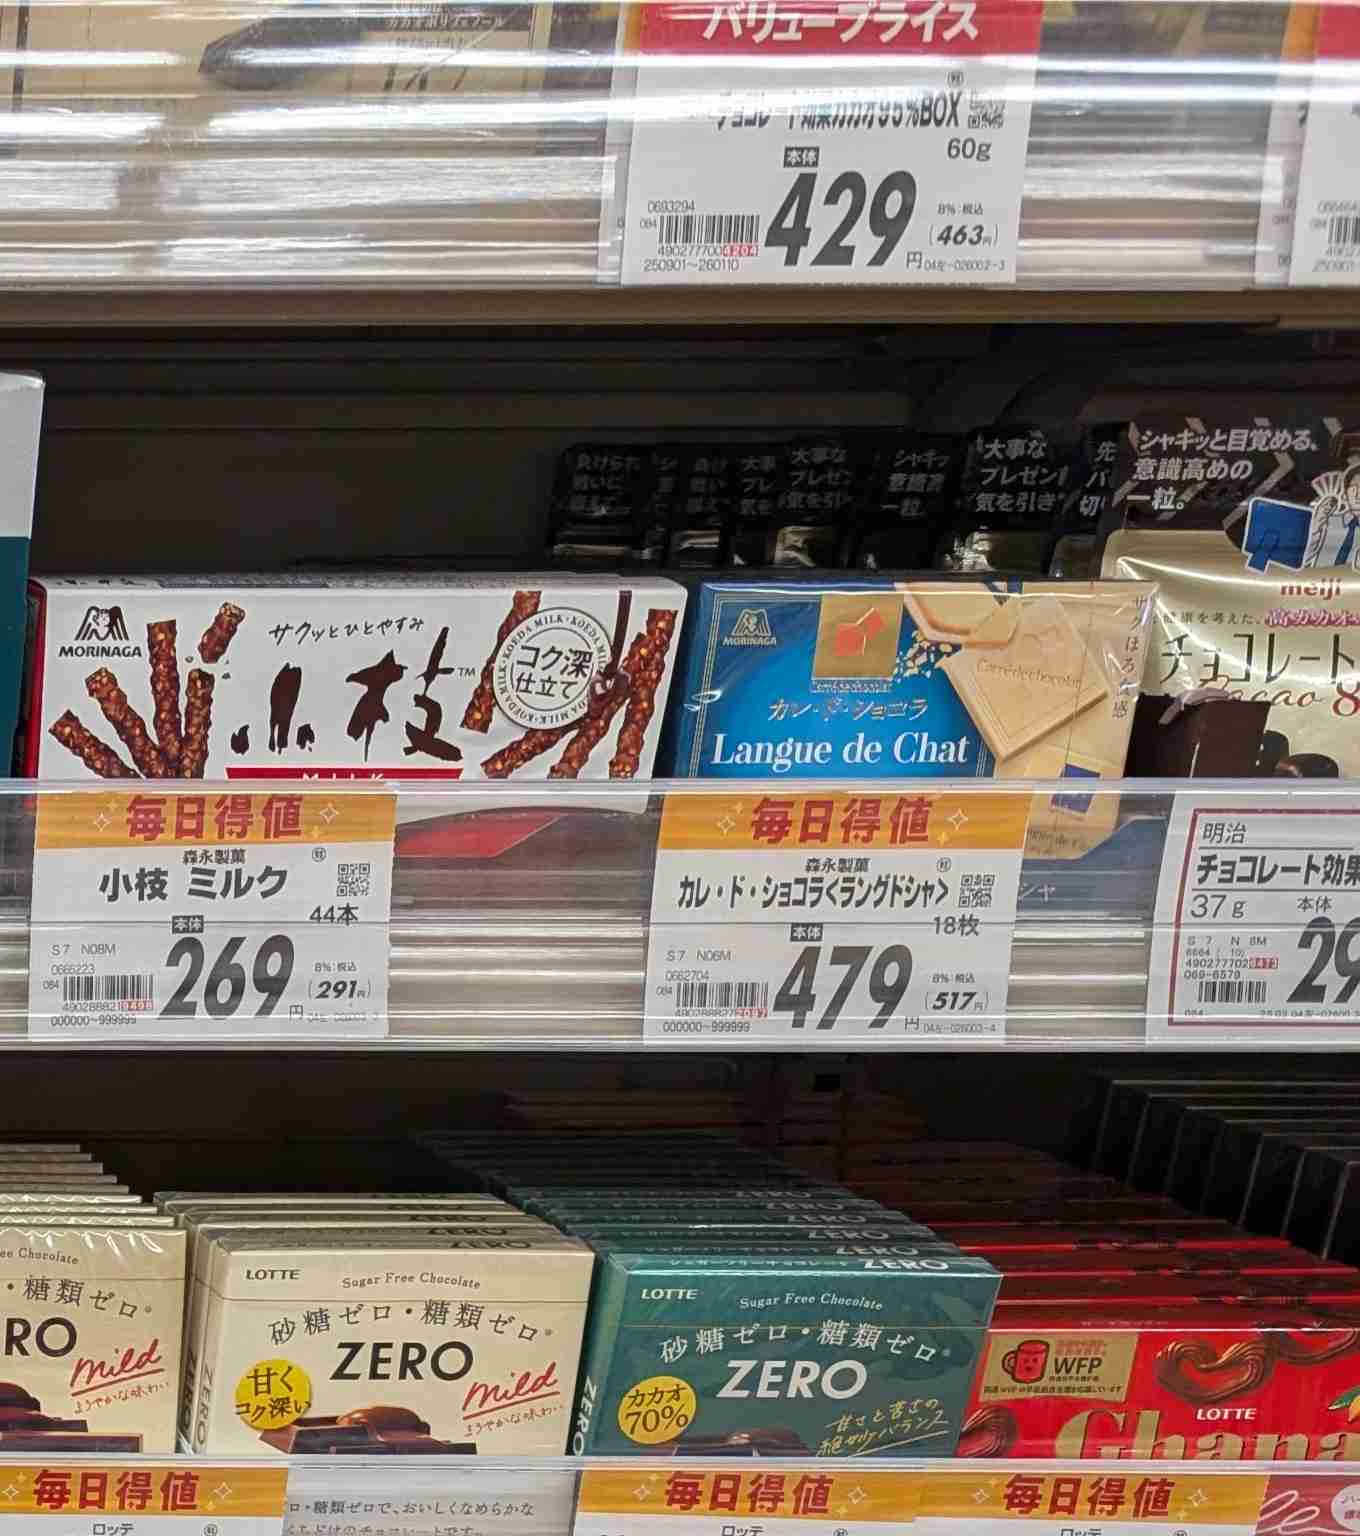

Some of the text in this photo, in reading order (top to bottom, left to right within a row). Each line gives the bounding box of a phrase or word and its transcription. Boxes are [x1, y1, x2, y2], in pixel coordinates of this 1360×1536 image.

[946, 136, 991, 162] 60g
[765, 170, 918, 268] 429
[1134, 458, 1253, 483] 意識高めの
[58, 646, 142, 658] MORINAGA
[712, 731, 969, 769] Langue de Chat
[1202, 822, 1247, 844] 明治
[182, 849, 246, 864] 森永製菓
[805, 857, 870, 873] 森永製菓
[98, 866, 288, 902] 小枝 ミルク
[309, 904, 360, 925] 44本
[932, 913, 980, 937] 18枚
[159, 935, 296, 1020] 269
[773, 943, 914, 1031] 479
[342, 1272, 481, 1289] Sugar Free Chocolate
[329, 1340, 474, 1381] ZERO
[1054, 1356, 1102, 1375] WFP
[716, 1359, 868, 1399] ZERO
[625, 1409, 689, 1435] 70%
[1197, 1408, 1257, 1421] LOTTE
[93, 1523, 134, 1536] ロッテ
